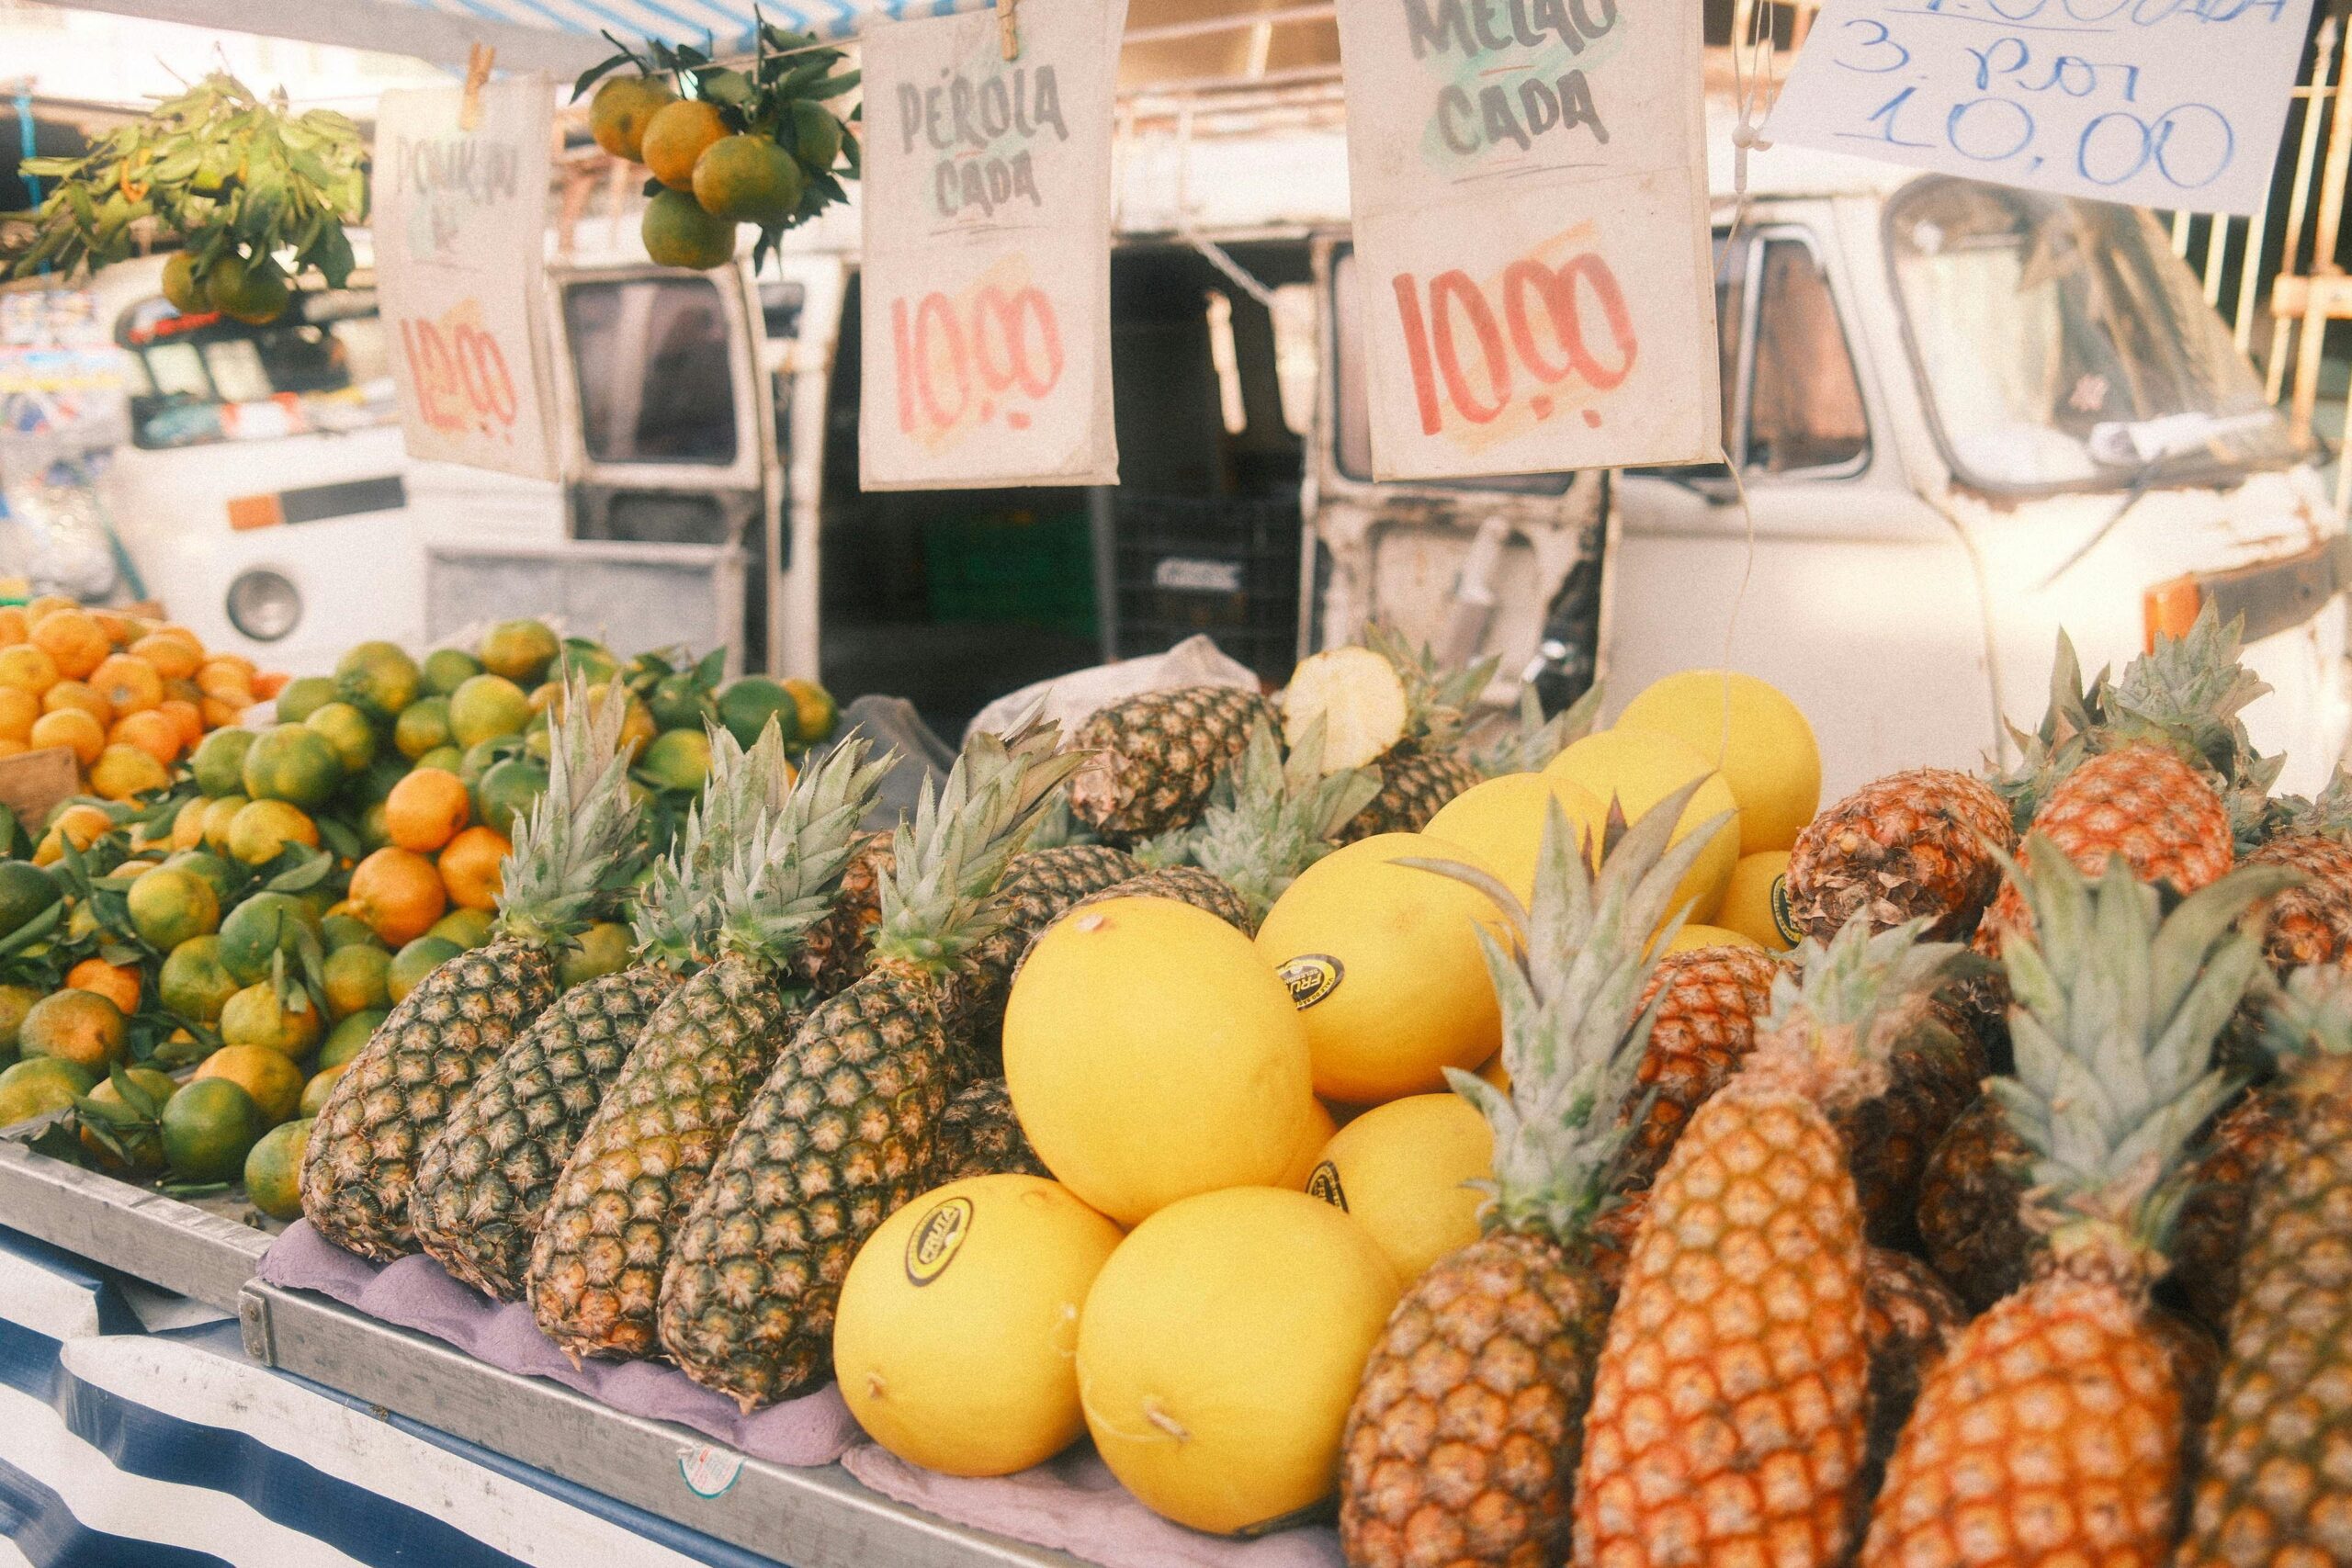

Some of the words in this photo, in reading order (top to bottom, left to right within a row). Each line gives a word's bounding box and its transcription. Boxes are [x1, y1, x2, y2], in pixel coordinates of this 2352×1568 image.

[896, 64, 1069, 154] PÉROLA
[1437, 69, 1610, 155] CADA
[1834, 86, 2234, 188] 10,00
[934, 149, 1042, 218] CADA
[1290, 972, 1322, 995] FRU
